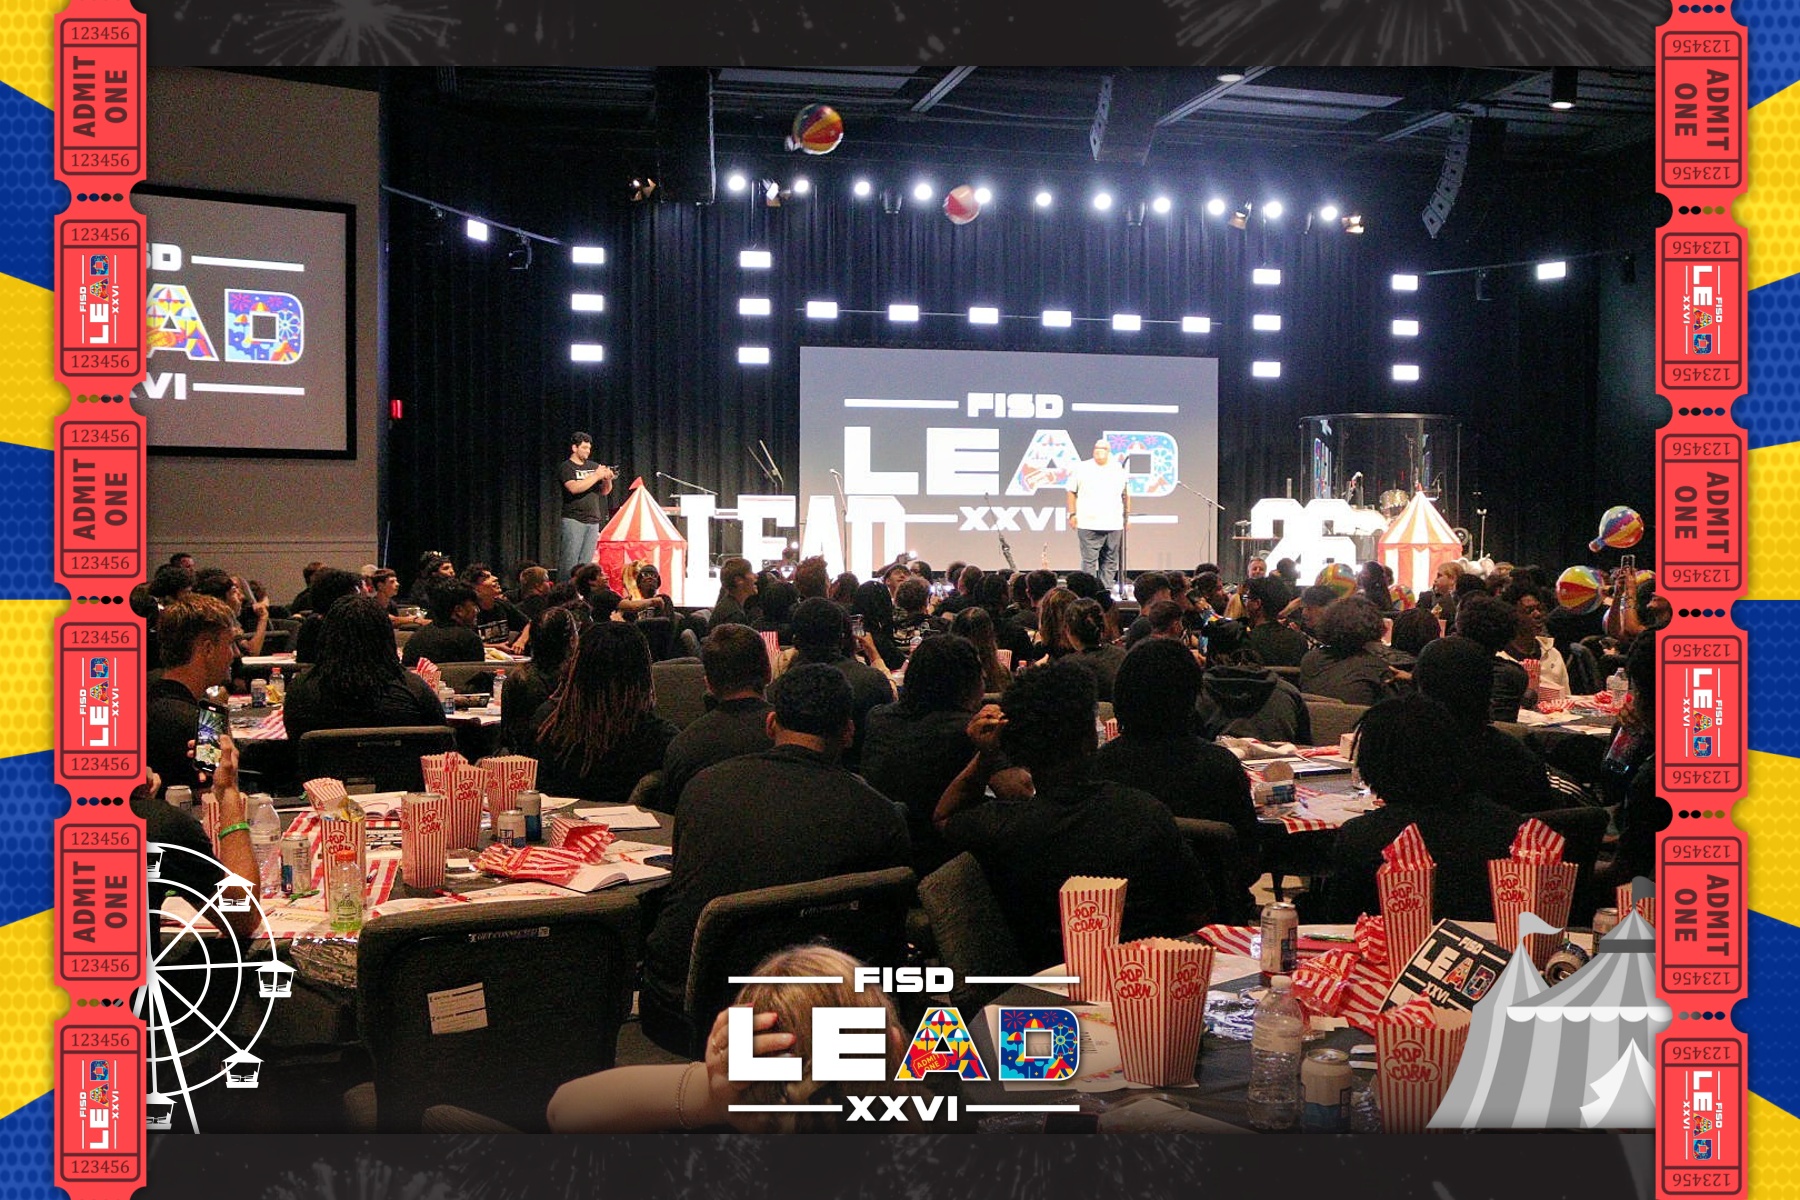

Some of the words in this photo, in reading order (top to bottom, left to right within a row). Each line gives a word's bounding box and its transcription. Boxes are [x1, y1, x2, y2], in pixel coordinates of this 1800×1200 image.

[967, 392, 1064, 419] FISD
[844, 426, 1179, 496] LEAD
[958, 506, 1067, 532] XXVI
[1251, 498, 1356, 586] 26
[459, 781, 474, 791] POP
[457, 789, 479, 800] CORN
[422, 812, 436, 824] POP
[420, 821, 440, 834] CORN
[329, 835, 344, 844] POP
[1500, 878, 1519, 890] POP
[1391, 886, 1412, 900] POP
[1500, 890, 1524, 902] CORN
[1074, 905, 1097, 919] POP
[1392, 898, 1420, 912] CORN
[1073, 918, 1105, 933] CORN
[1458, 936, 1484, 955] FISD
[1120, 968, 1142, 982] POP
[1176, 968, 1197, 982] POP
[1412, 938, 1496, 1001] LEAD
[1121, 983, 1152, 999] CORN
[1175, 981, 1202, 1000] CORN
[1425, 981, 1450, 1004] XXVI
[1393, 1047, 1422, 1063] POP
[1392, 1065, 1432, 1082] CORN
